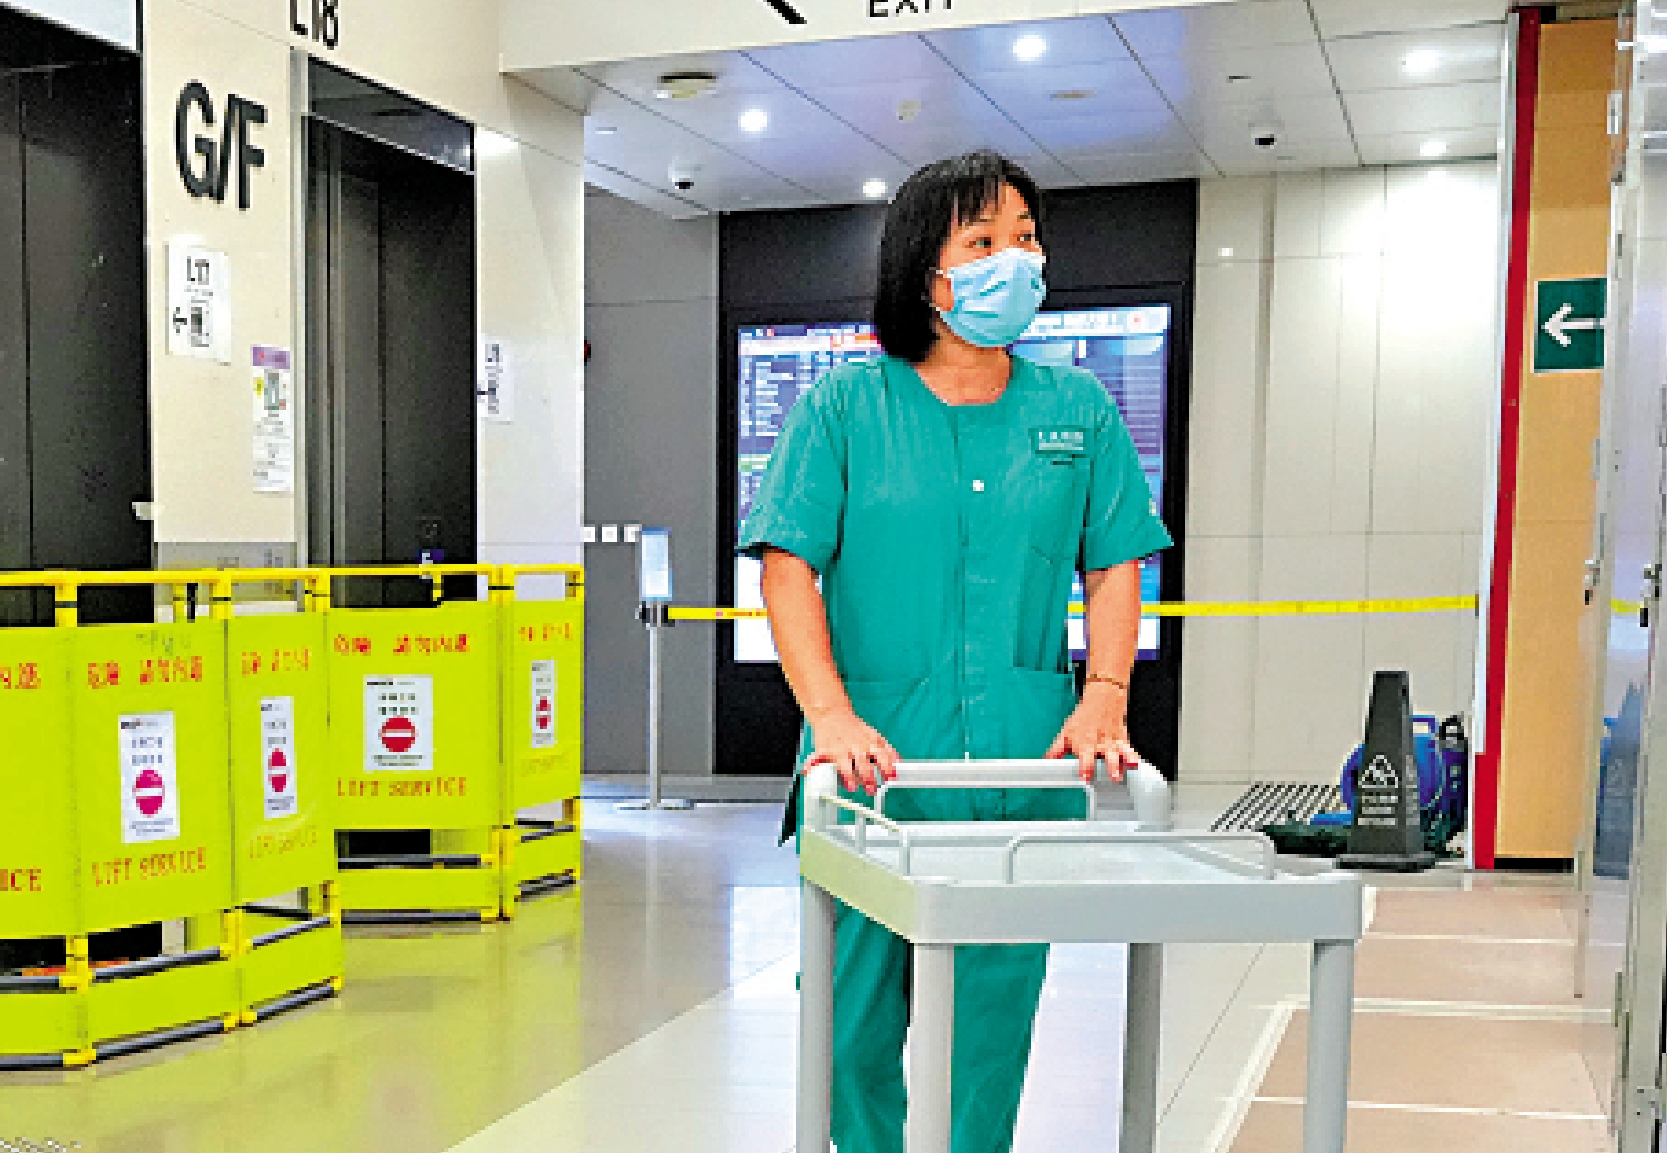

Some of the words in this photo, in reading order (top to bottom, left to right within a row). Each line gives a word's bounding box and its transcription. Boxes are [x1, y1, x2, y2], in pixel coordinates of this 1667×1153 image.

[289, 0, 338, 50] L18
[176, 79, 268, 211] G/F
[338, 781, 378, 796] LIFT
[389, 777, 465, 796] SERVICE
